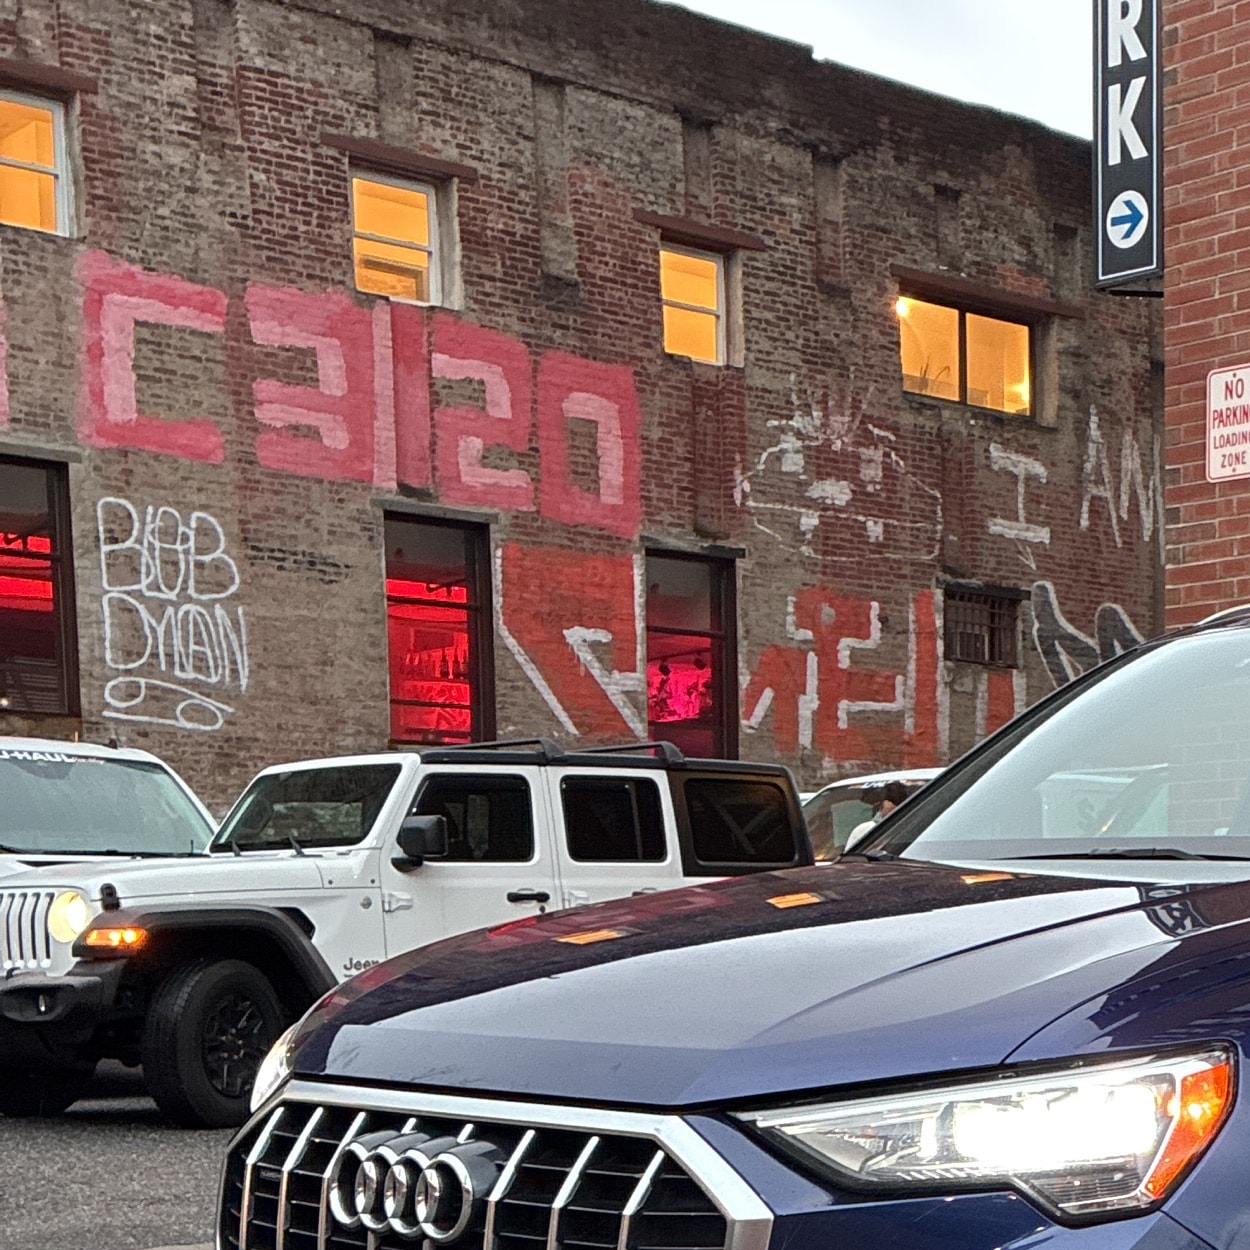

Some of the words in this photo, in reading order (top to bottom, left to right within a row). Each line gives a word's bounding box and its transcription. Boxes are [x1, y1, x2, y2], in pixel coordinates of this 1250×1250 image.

[1224, 378, 1245, 401] NO
[1221, 450, 1247, 468] ZONE
[343, 957, 380, 971] Jee
